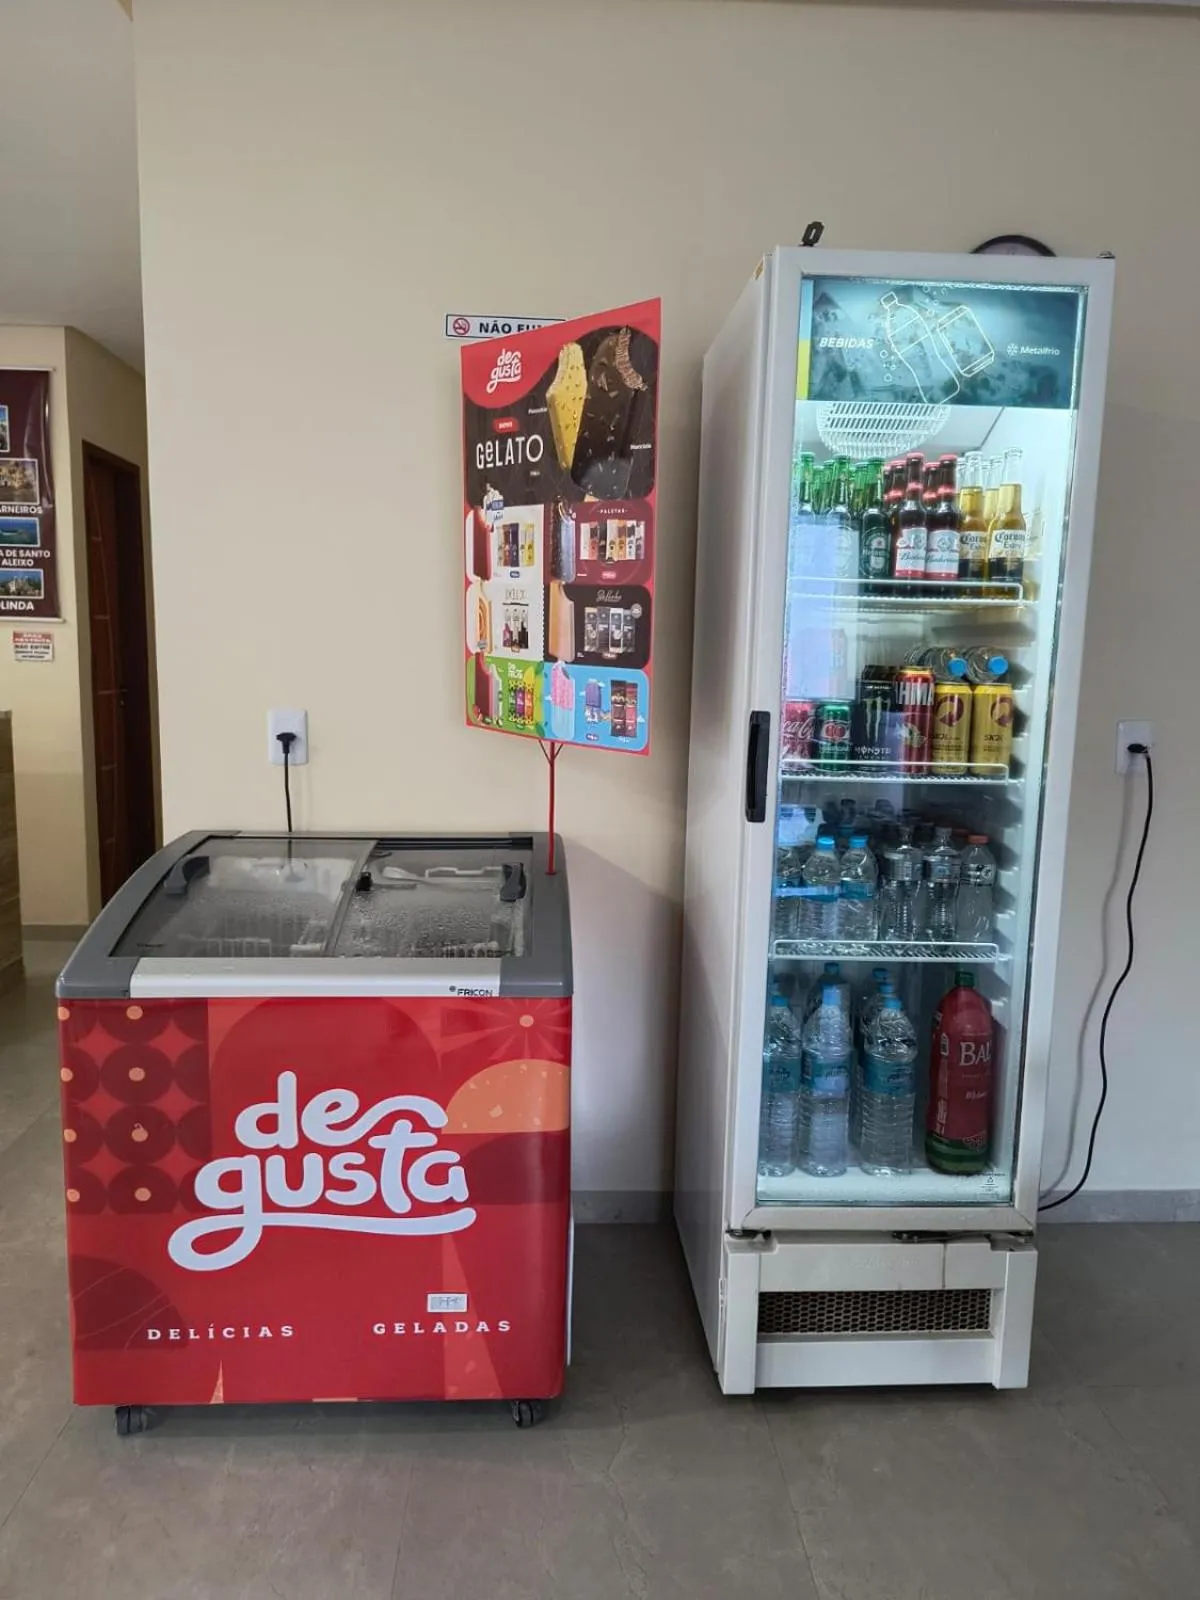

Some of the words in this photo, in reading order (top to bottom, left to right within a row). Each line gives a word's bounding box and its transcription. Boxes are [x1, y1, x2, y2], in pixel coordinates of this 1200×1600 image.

[479, 320, 512, 334] NÃO
[819, 337, 874, 349] BEBIDAS
[1020, 345, 1060, 356] Metalfrio
[486, 361, 522, 393] gusta
[0, 506, 43, 514] RNEIROS
[19, 550, 50, 558] SANTO
[0, 601, 35, 610] LINDA
[457, 988, 493, 997] FRICON
[167, 1119, 477, 1272] gusta
[147, 1324, 294, 1341] DELÍCIAS
[372, 1320, 512, 1335] GELADAS
